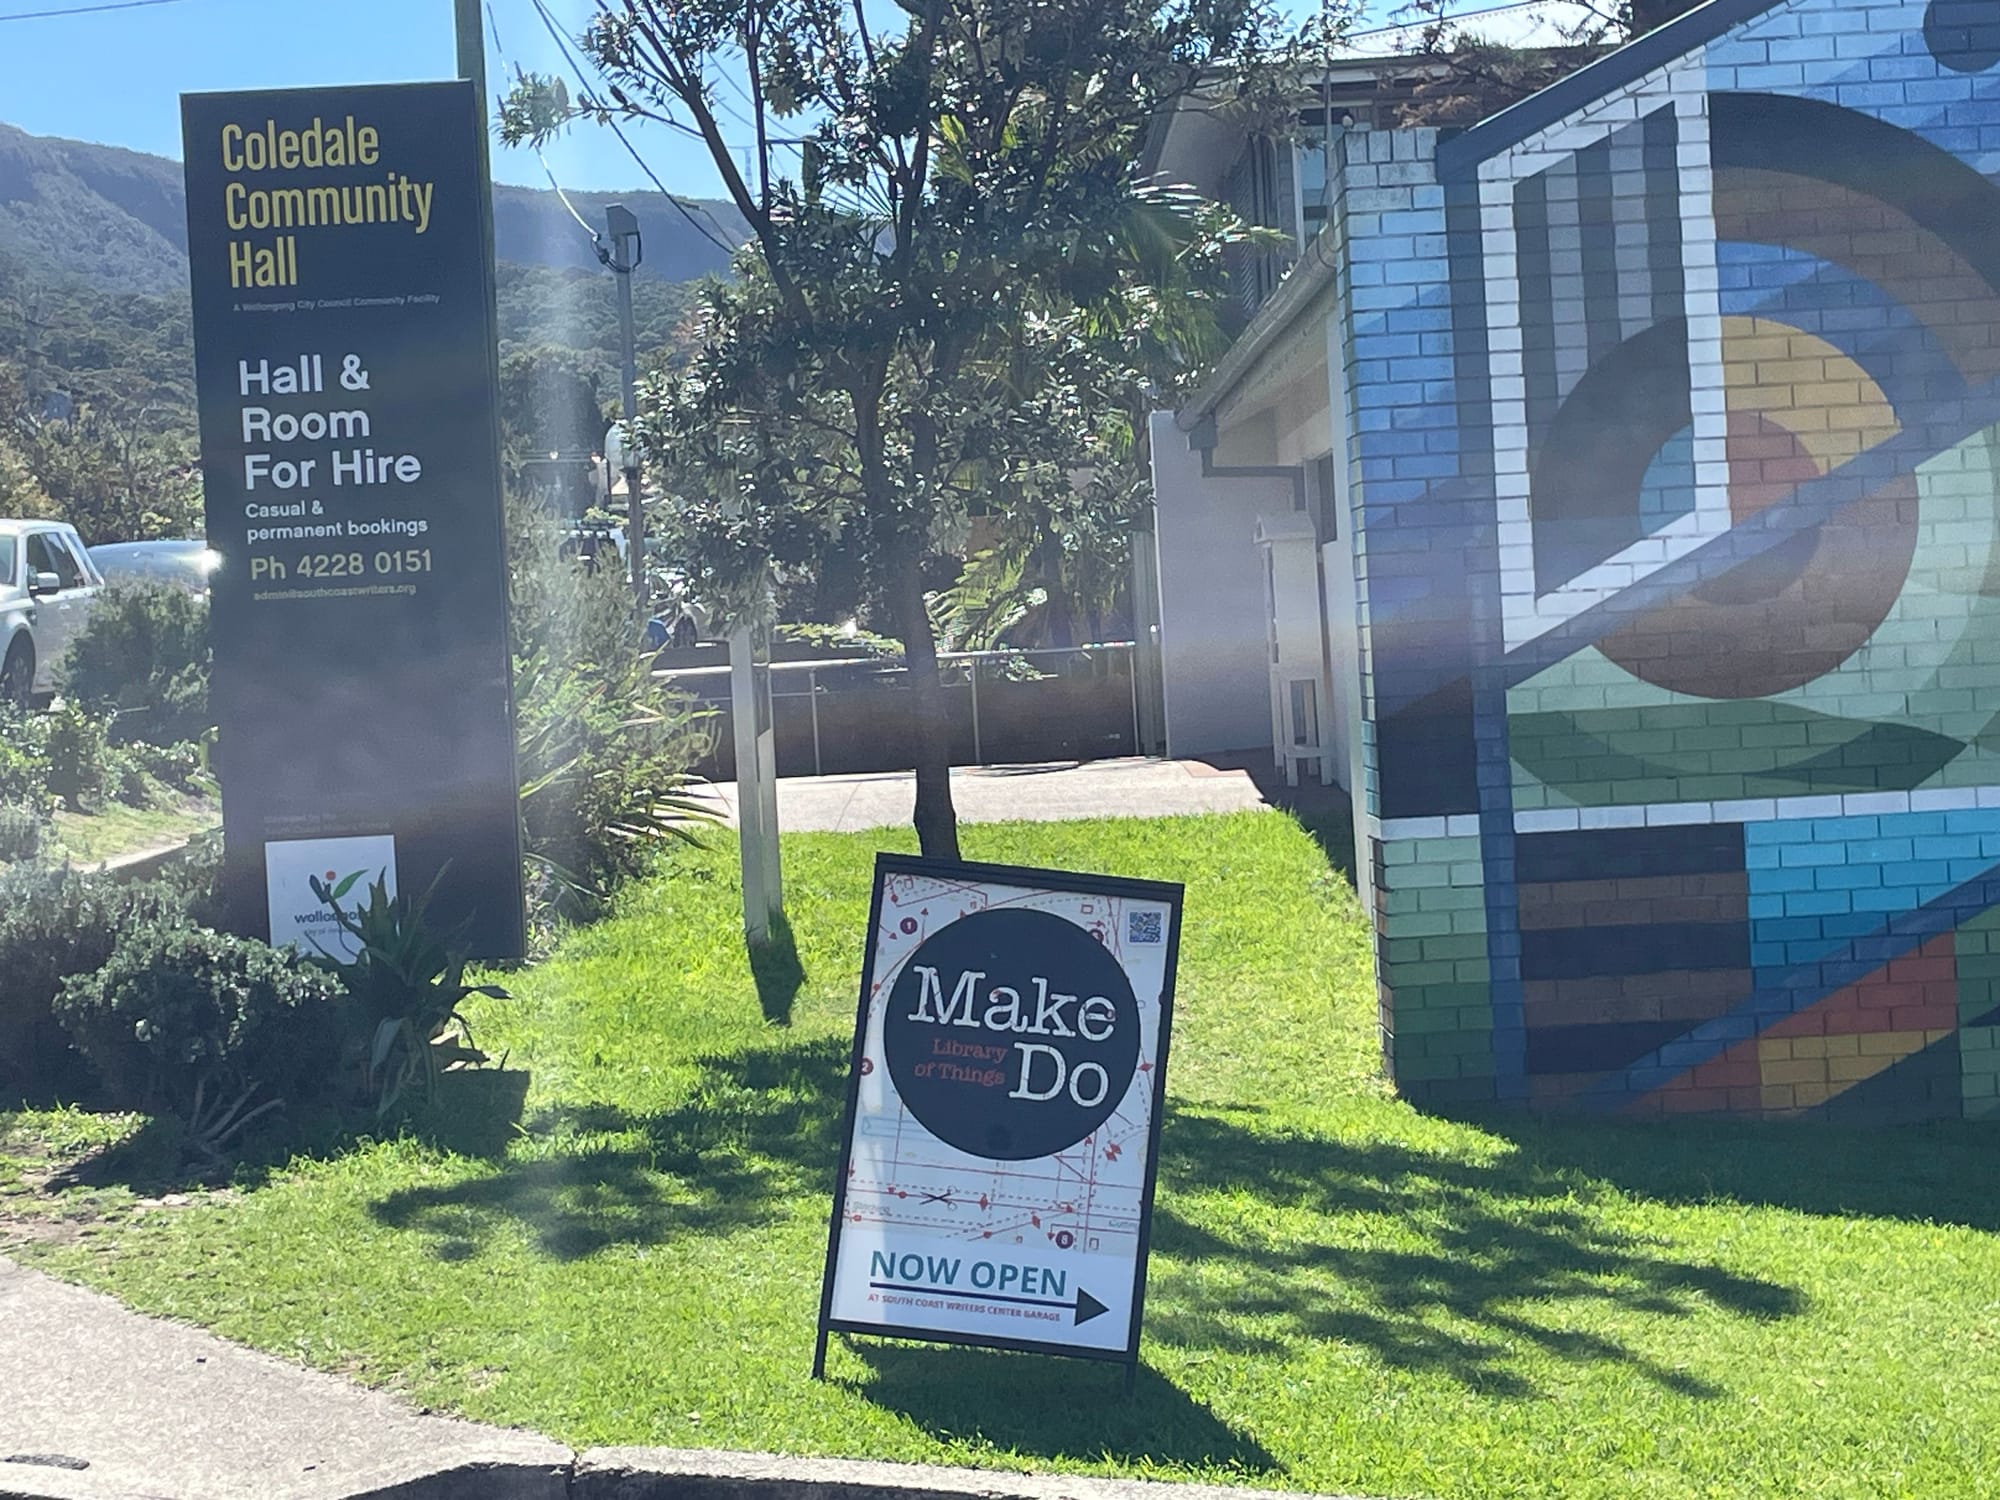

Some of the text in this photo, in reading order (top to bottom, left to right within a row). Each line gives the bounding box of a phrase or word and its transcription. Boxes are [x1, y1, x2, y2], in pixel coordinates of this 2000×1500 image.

[221, 115, 380, 172] Coledale
[225, 172, 434, 235] Community
[229, 235, 298, 289] Hall
[297, 299, 316, 311] City
[317, 298, 352, 308] Council
[353, 296, 406, 306] Community
[407, 293, 441, 304] Facility
[239, 354, 370, 395] Hall &
[242, 407, 370, 443] Room
[245, 449, 422, 490] For Hire
[245, 500, 324, 519] Casual &
[247, 518, 428, 544] permanent bookings
[251, 549, 432, 581] Ph 4228 0151
[908, 966, 1116, 1041] Make
[932, 1038, 1009, 1064] Library
[914, 1061, 1006, 1088] of Things
[1008, 1041, 1110, 1107] Do
[870, 1250, 1067, 1297] NOW OPEN
[867, 1293, 1060, 1322] AT SOUTH COAST WRITERS CENTER GARAGE
